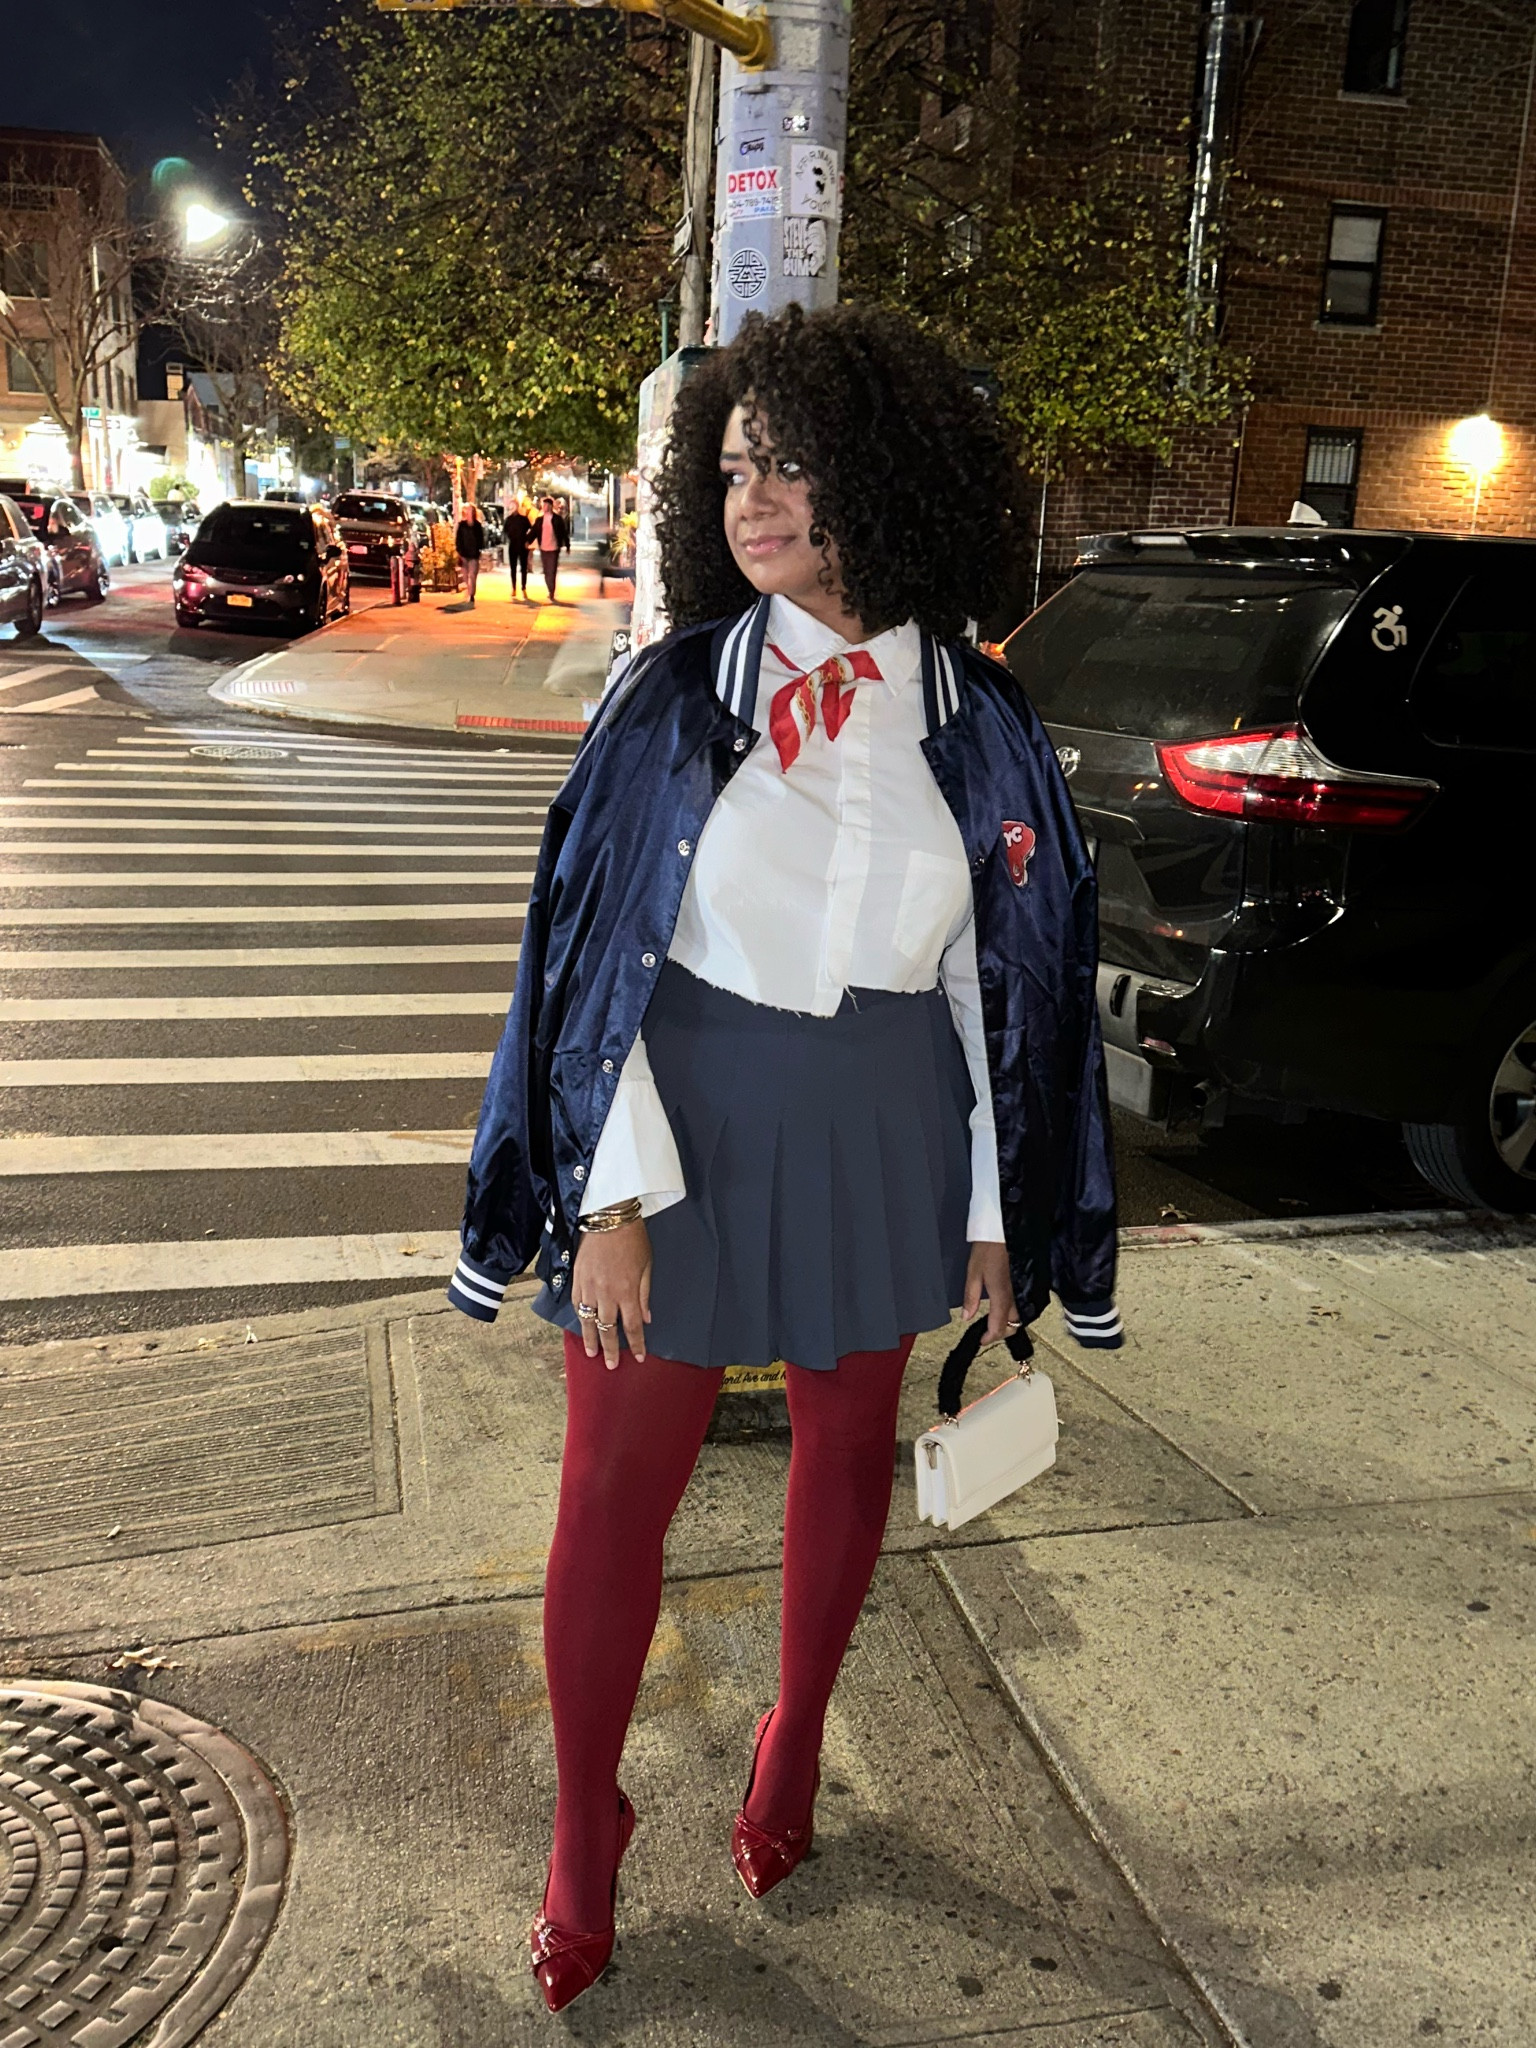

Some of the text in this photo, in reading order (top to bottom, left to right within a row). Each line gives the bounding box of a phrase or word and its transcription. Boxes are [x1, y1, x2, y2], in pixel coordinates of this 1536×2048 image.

[728, 169, 777, 193] DETOX
[785, 248, 805, 259] THE
[1003, 826, 1023, 848] YC
[743, 1372, 759, 1383] Ave
[760, 1370, 781, 1382] and
